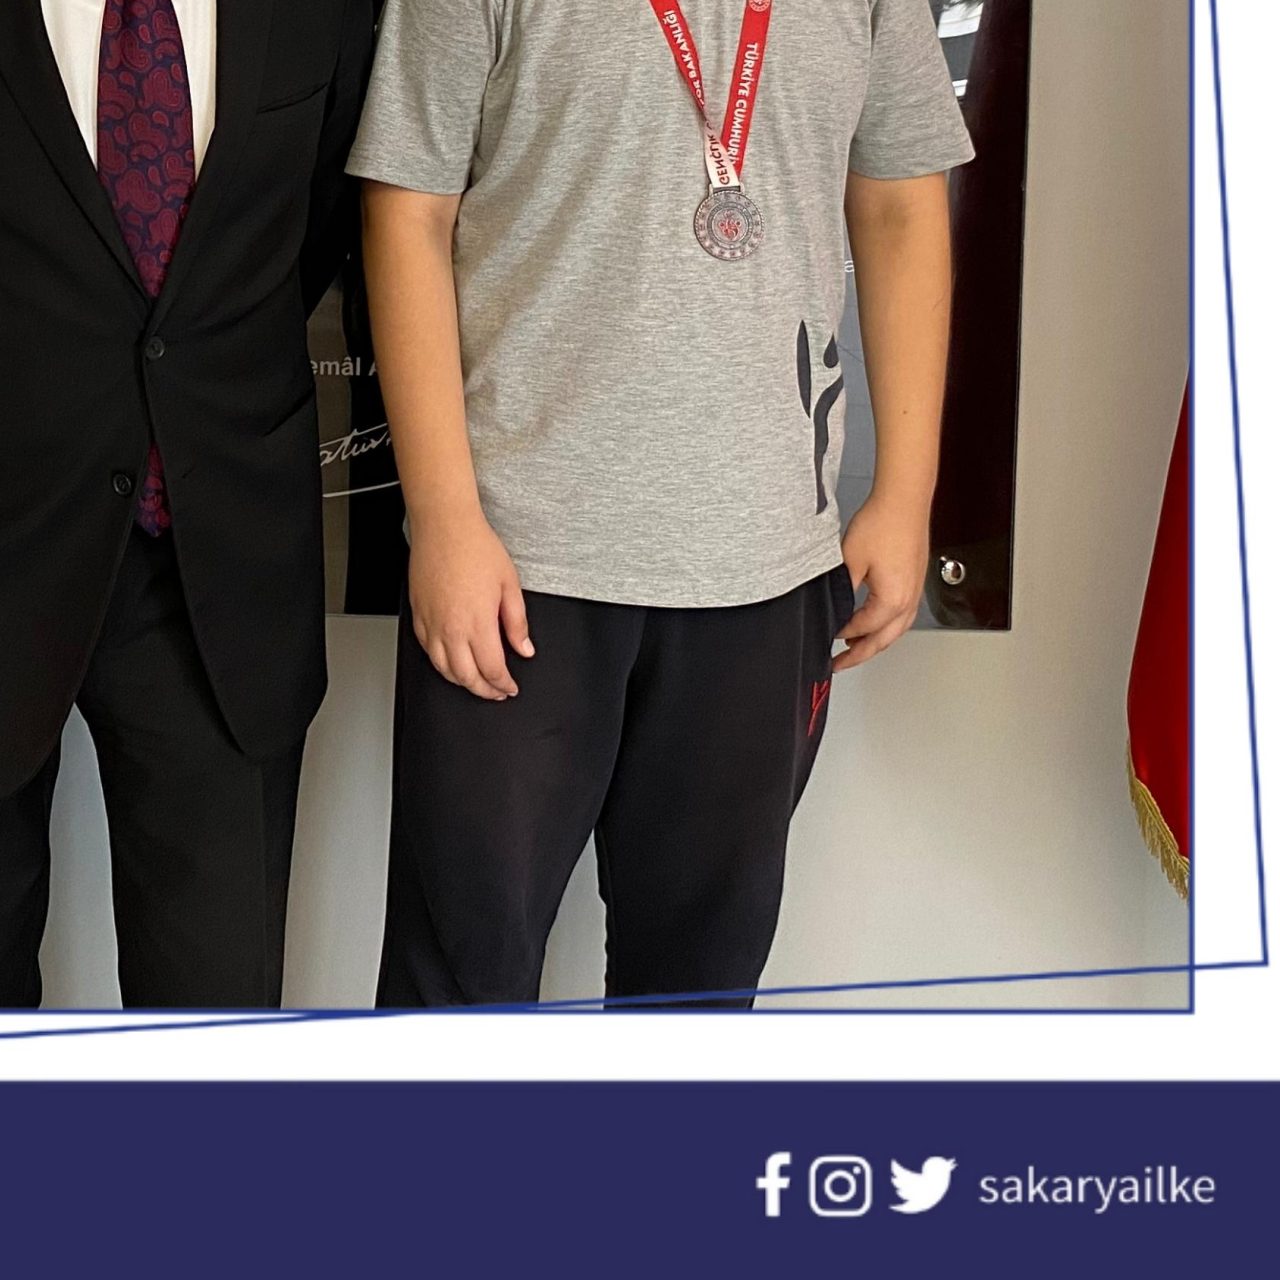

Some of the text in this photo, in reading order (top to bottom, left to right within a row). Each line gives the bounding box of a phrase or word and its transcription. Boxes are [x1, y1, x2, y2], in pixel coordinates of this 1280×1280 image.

[663, 10, 698, 78] BAKANLIĞI
[727, 42, 759, 164] TÜRKİYE CUMHURİ
